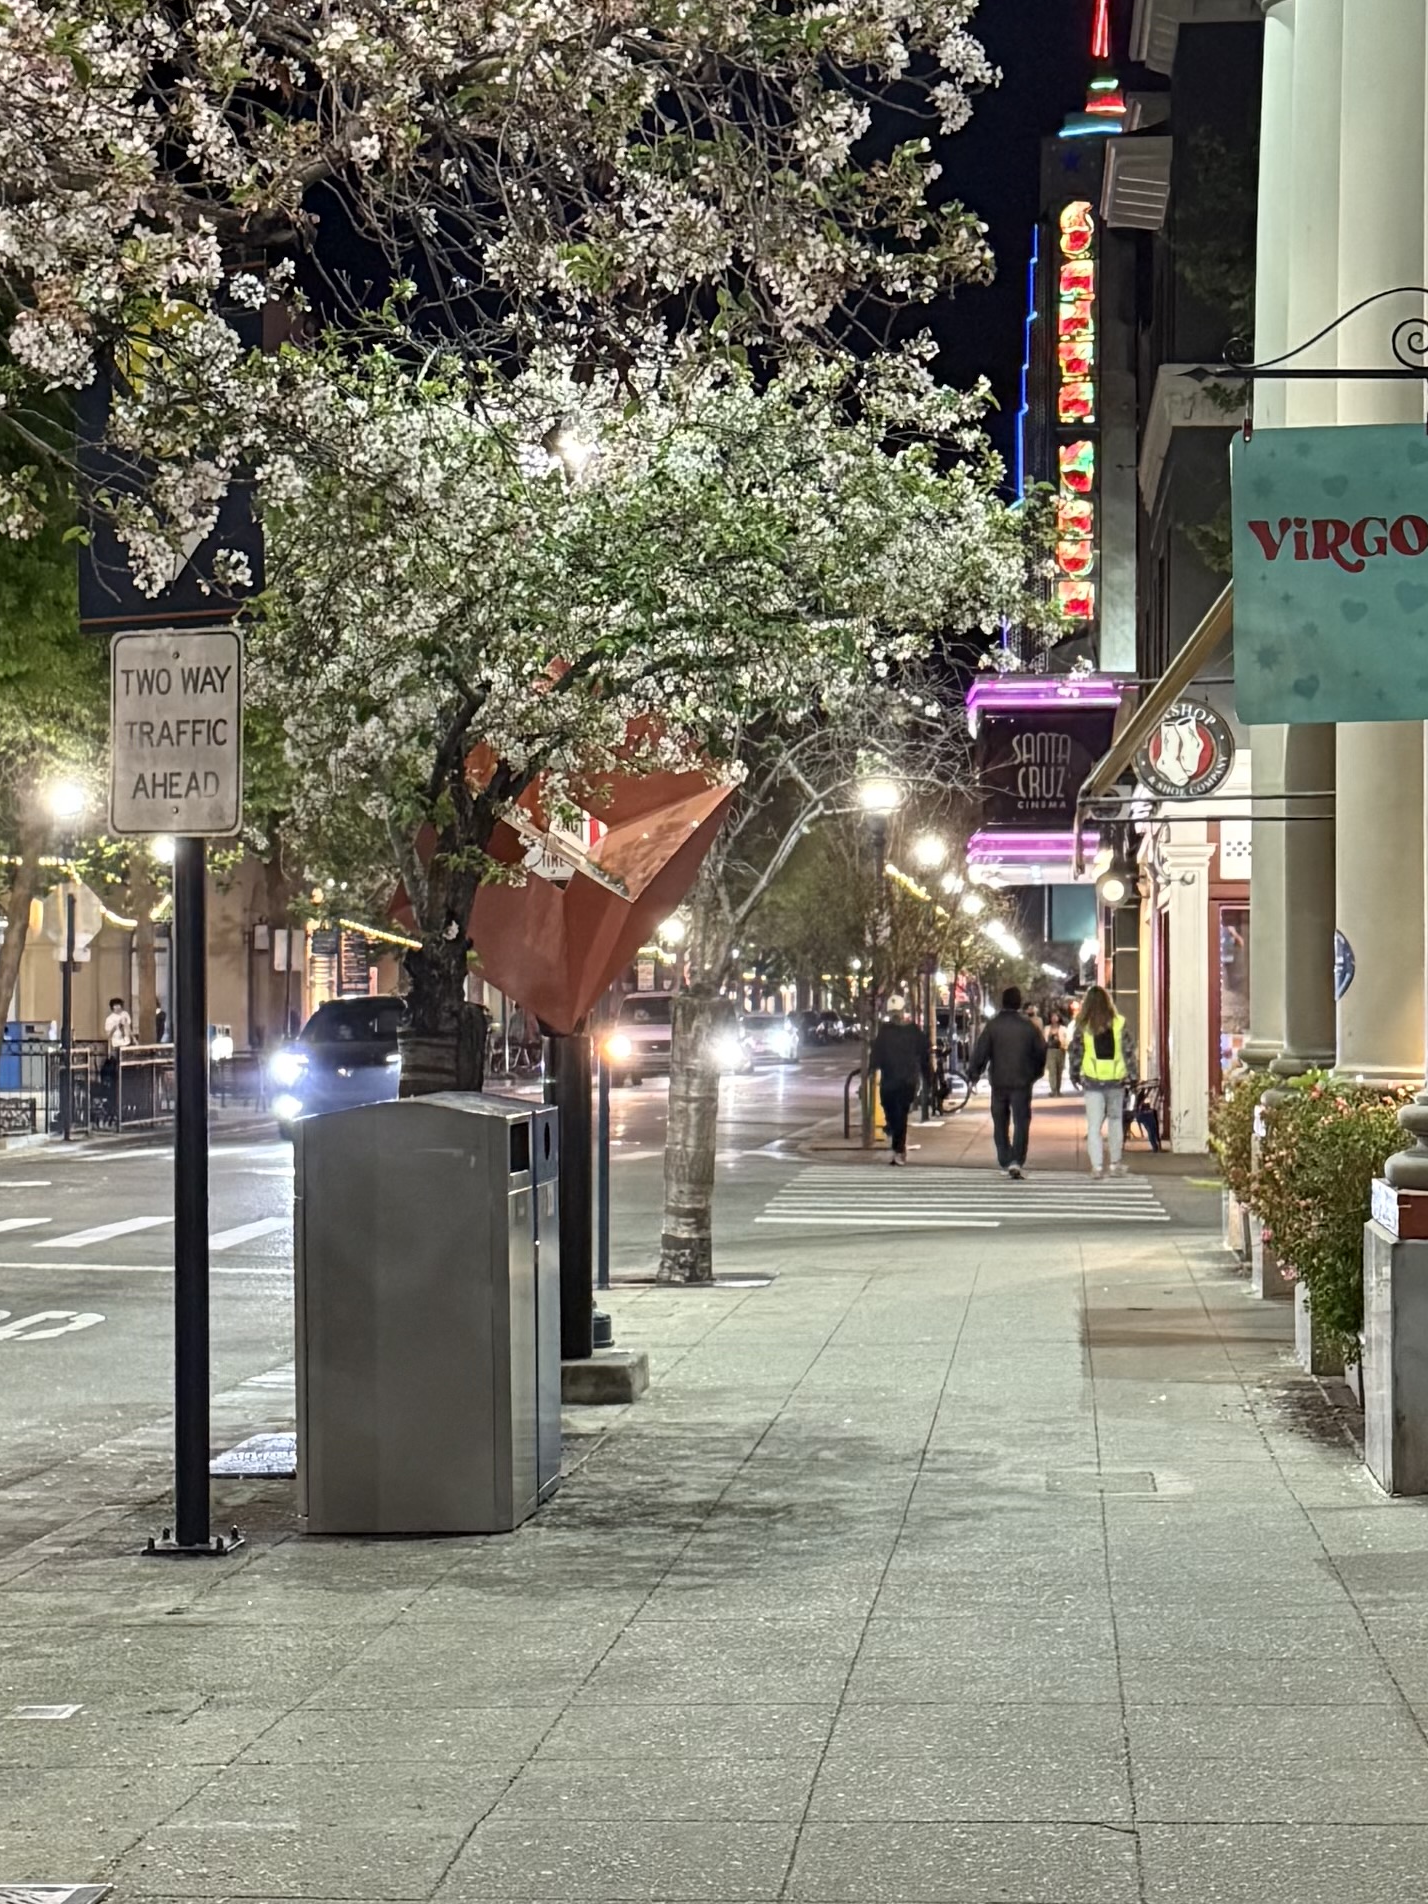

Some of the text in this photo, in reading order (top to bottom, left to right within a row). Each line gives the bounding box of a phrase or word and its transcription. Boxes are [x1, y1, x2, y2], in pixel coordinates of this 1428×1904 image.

[121, 665, 232, 696] TWO WAY
[123, 718, 228, 748] TRAFFIC
[1012, 731, 1072, 766] SANTA
[132, 770, 220, 800] AHEAD
[1018, 766, 1067, 800] CRUZ
[1157, 781, 1188, 798] SHOE
[1189, 754, 1229, 796] COMPANY
[1017, 800, 1068, 810] CINEMA
